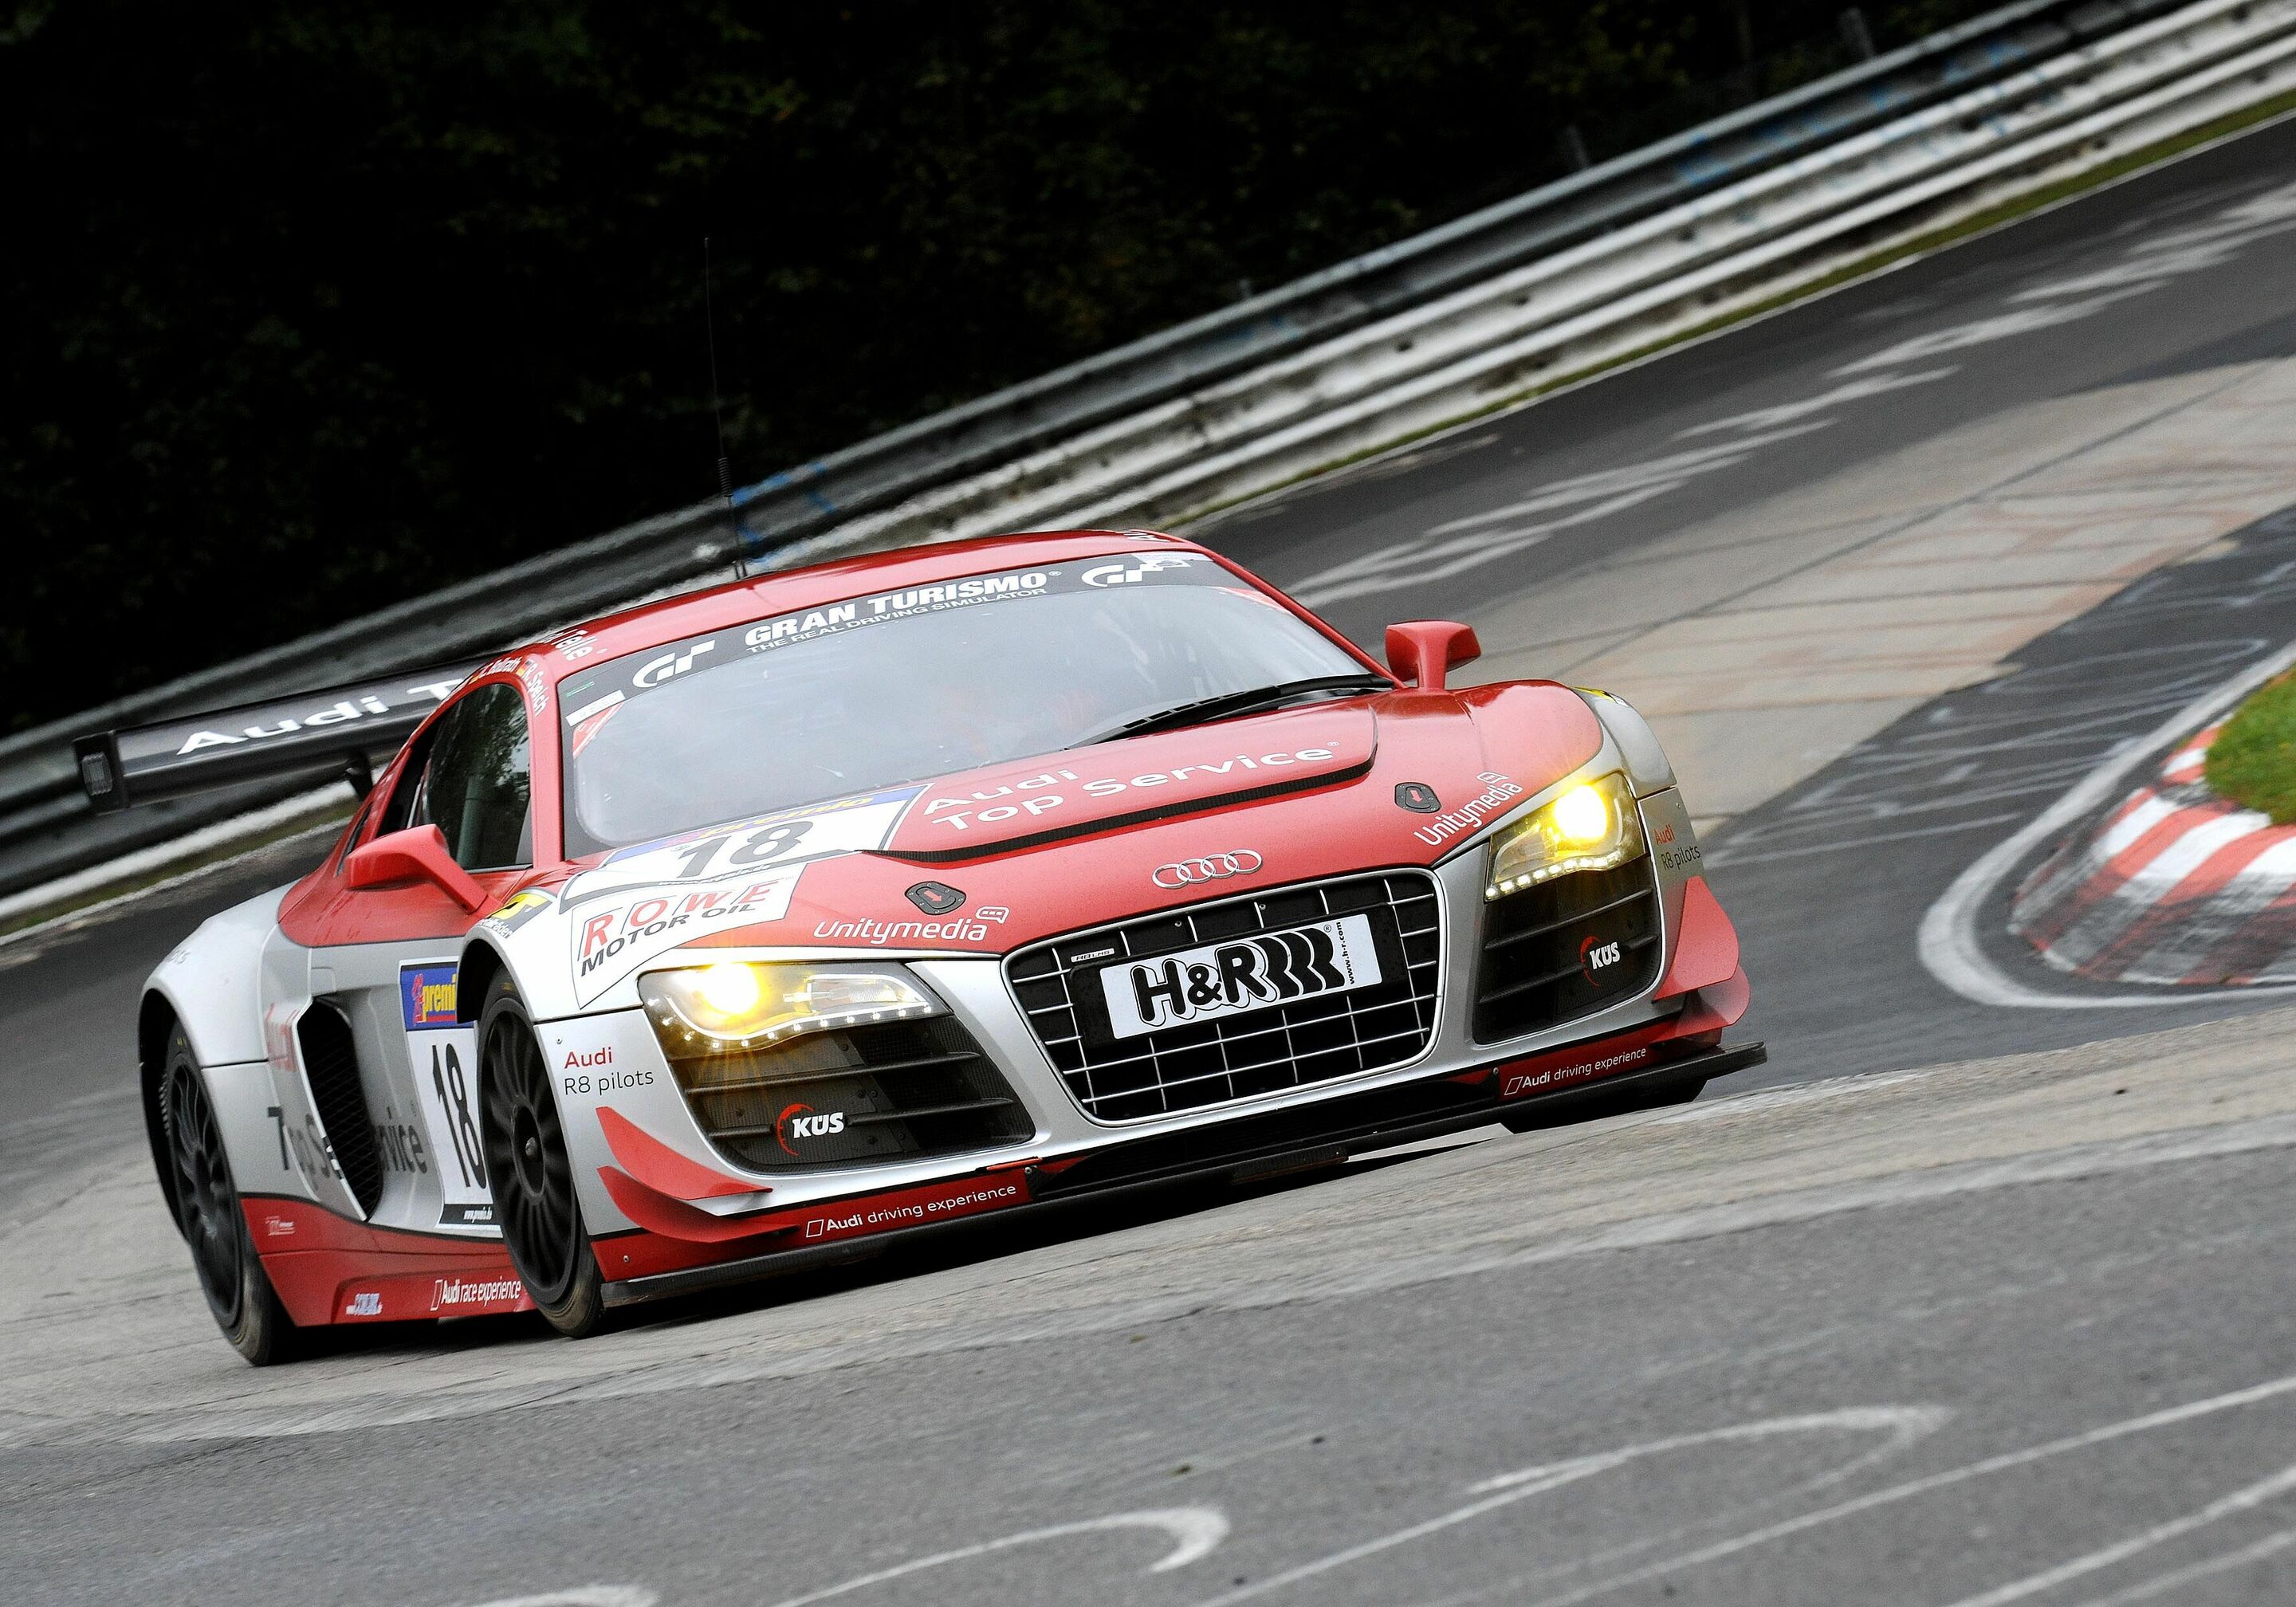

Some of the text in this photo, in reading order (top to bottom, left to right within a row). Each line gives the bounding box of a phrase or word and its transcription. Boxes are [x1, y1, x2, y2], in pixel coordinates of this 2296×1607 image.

[745, 603, 856, 646] GRAN
[746, 588, 1048, 654] THE REAL DRIVING SIMULATOR
[176, 695, 390, 756] Audi
[922, 768, 1079, 816] Audi
[932, 792, 1065, 831] Top
[1413, 780, 1523, 846] Unitymedia
[676, 819, 814, 879] 18
[1654, 823, 1675, 846] Audi
[1661, 846, 1700, 870] R8 pilots
[581, 903, 757, 977] MOTOR OIL
[583, 882, 779, 957] ROWE
[813, 914, 987, 944] Unitymedia
[1336, 921, 1355, 984] www.h-r.com
[1589, 941, 1621, 970] KÜS
[564, 1047, 613, 1069] Audi
[1522, 1047, 1646, 1089] Audi driving experience
[564, 1069, 654, 1096] R8 pilots
[431, 1043, 487, 1190] 18
[792, 1111, 844, 1139] KÜS
[827, 1185, 1016, 1232] Audi driving experience
[441, 1275, 521, 1307] Audi race experience
